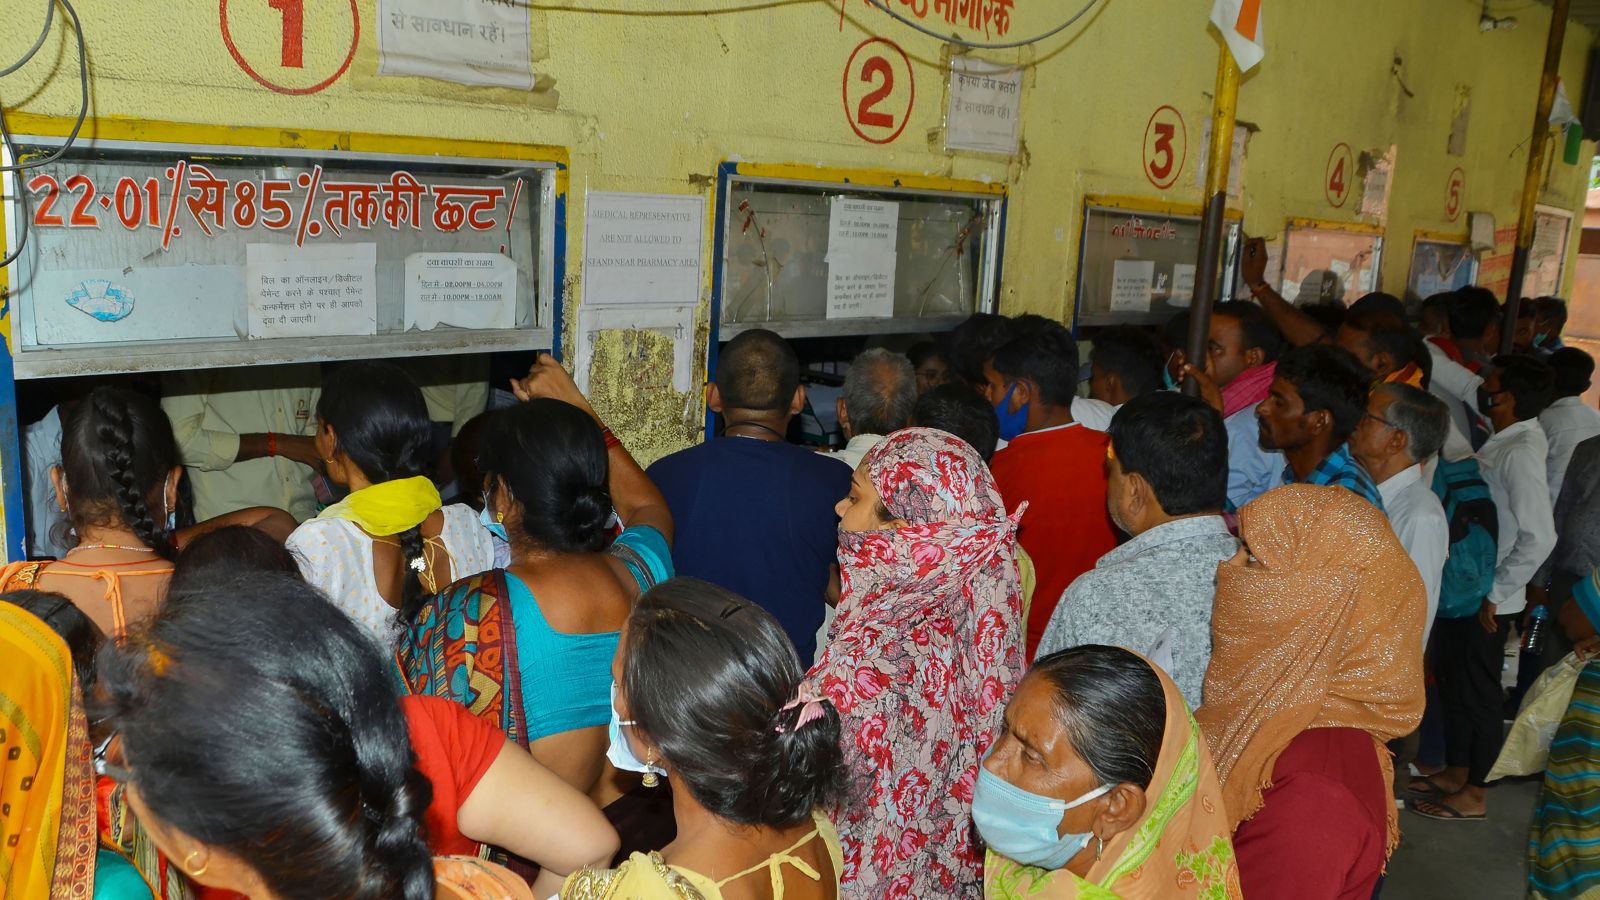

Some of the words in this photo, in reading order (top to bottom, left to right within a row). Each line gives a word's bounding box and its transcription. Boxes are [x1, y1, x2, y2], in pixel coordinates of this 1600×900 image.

[269, 0, 304, 68] 1
[391, 9, 406, 30] से
[411, 15, 474, 39] सावधान
[858, 56, 894, 128] 2
[1150, 123, 1175, 179] 3
[1329, 157, 1345, 198] 4
[1446, 180, 1461, 215] 5
[592, 209, 628, 220] MEDICAL
[630, 210, 692, 222] REPRESENTATIVE
[600, 233, 614, 243] ARE
[616, 234, 633, 243] NOT
[634, 235, 670, 245] ALLOWED
[672, 236, 682, 244] TO
[587, 257, 614, 267] STAND
[615, 258, 635, 267] NEAR
[637, 258, 678, 267] PHARMACY
[679, 258, 699, 267] AREA
[261, 275, 275, 285] बिल
[281, 276, 291, 284] का
